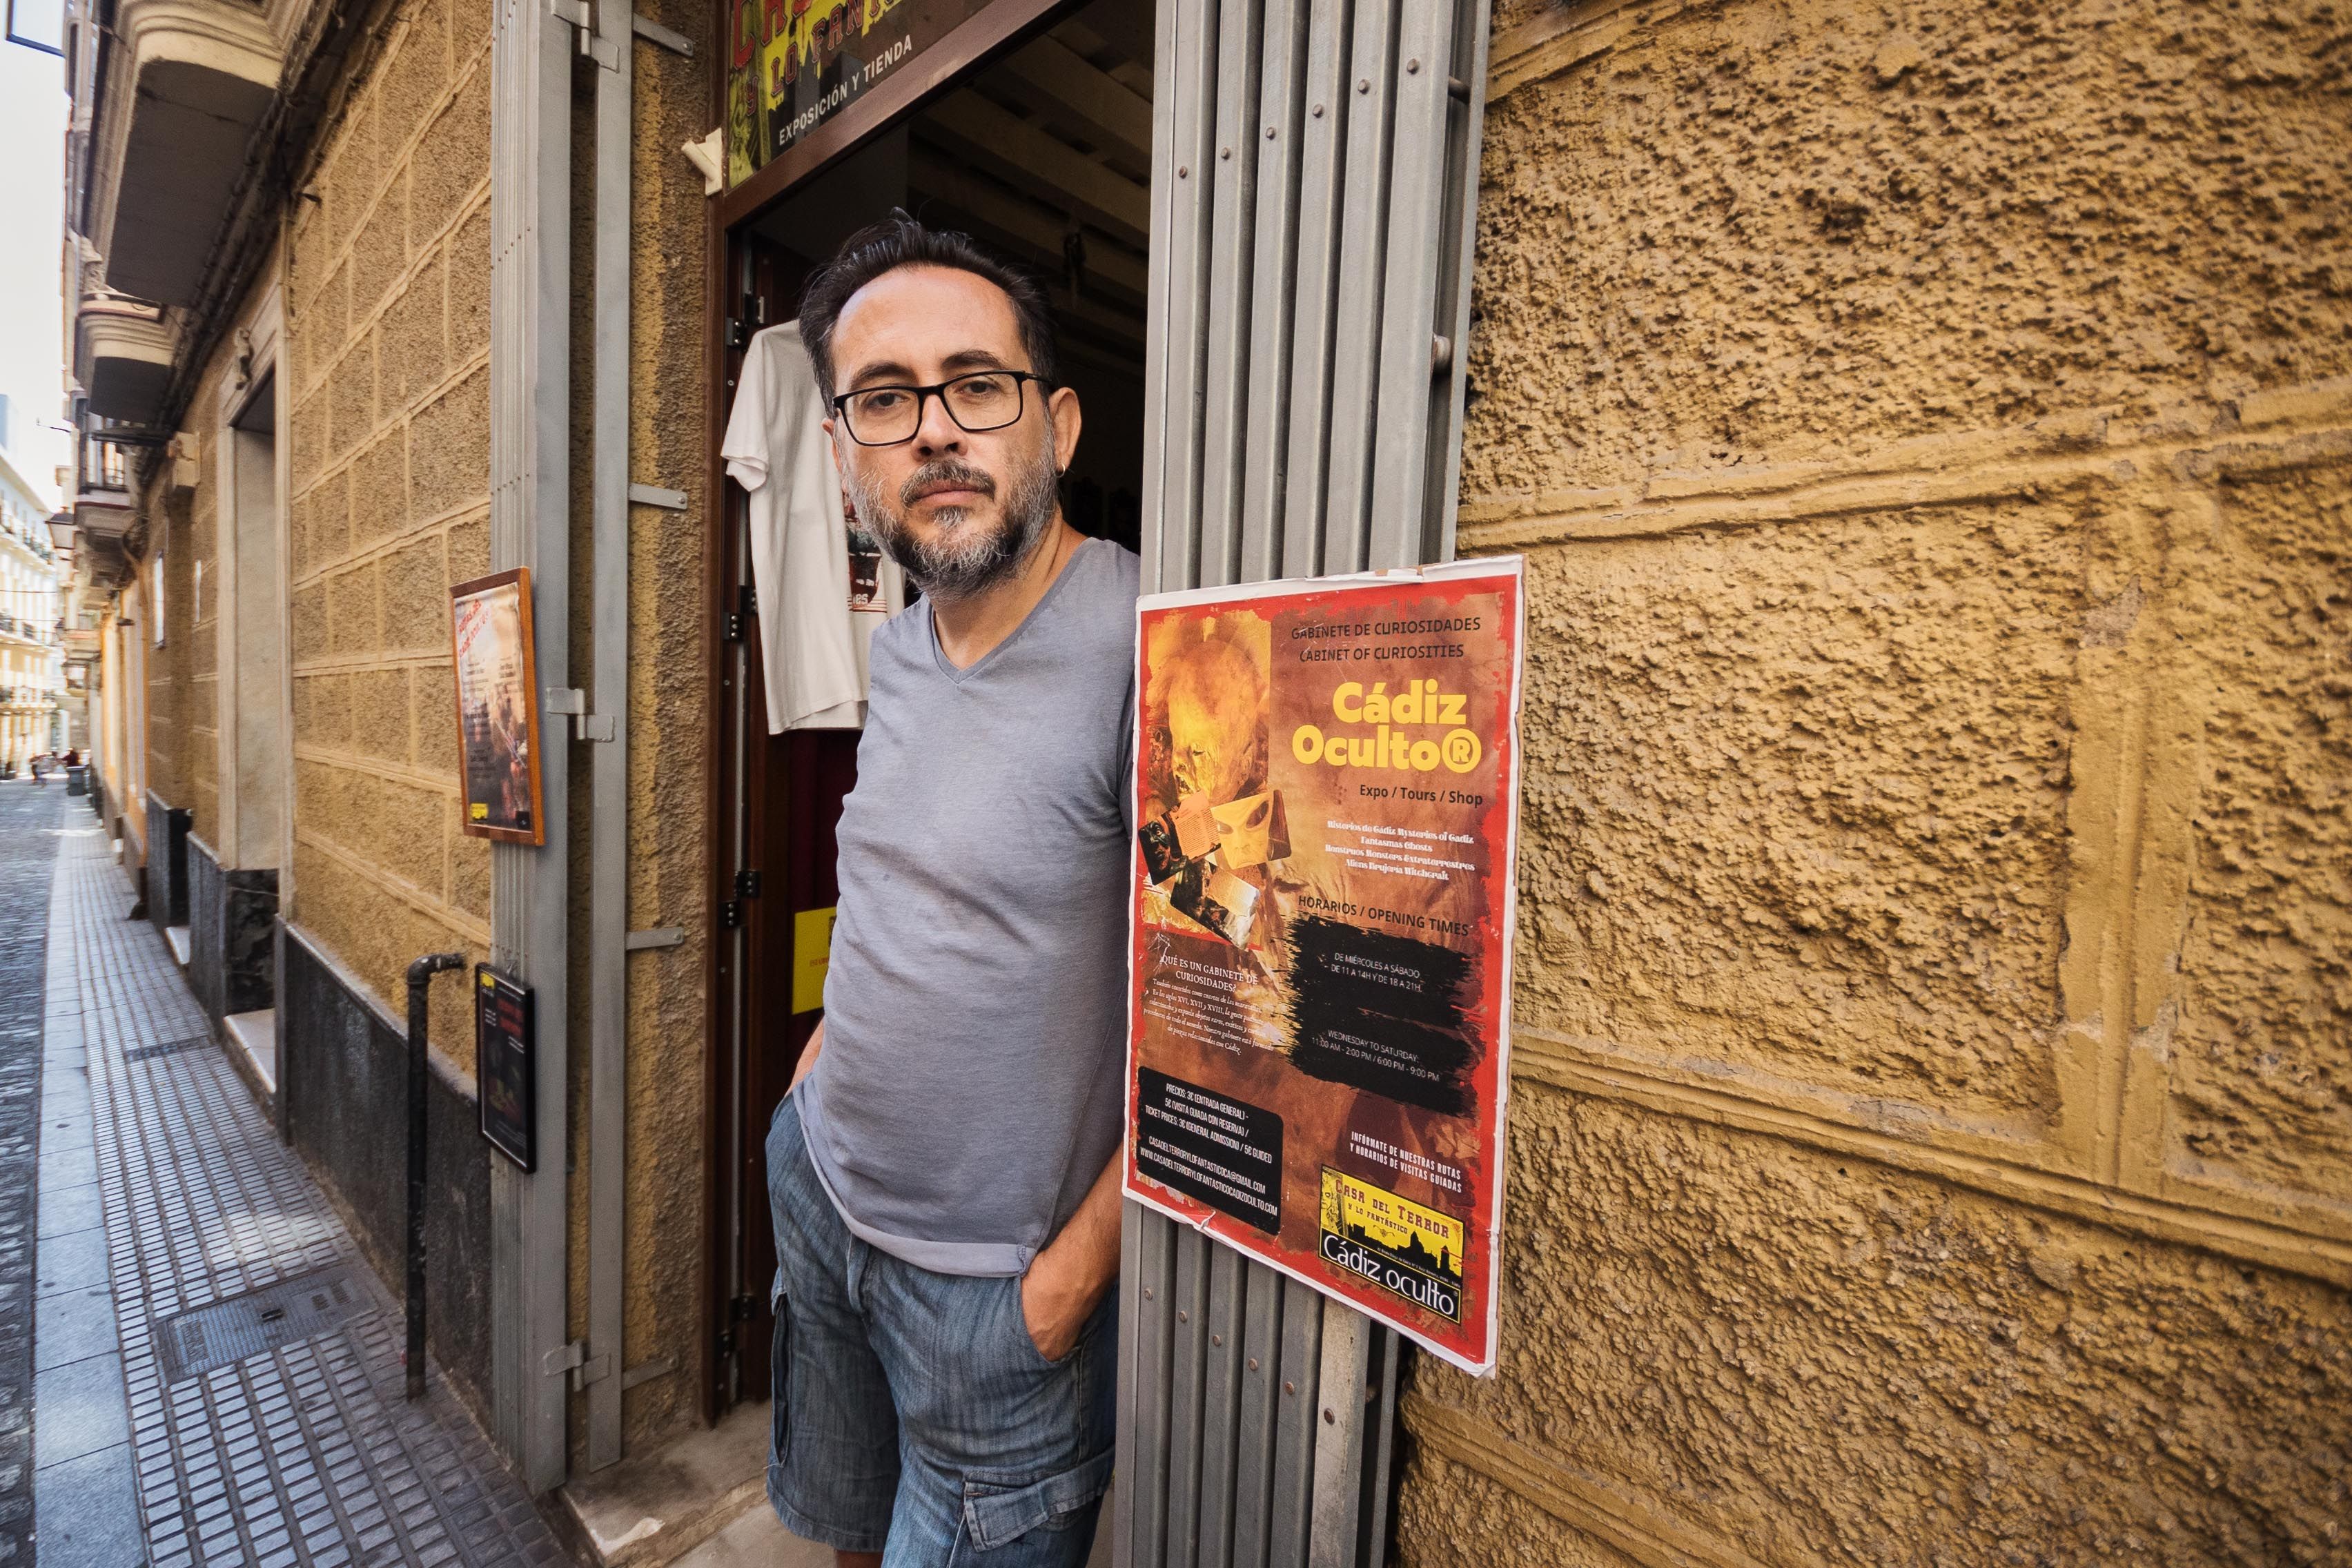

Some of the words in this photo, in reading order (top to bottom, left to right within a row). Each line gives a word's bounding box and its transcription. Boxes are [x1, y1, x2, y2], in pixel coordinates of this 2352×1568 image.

[770, 43, 798, 97] LO
[779, 81, 847, 146] EXPOSICIÓN
[852, 72, 860, 91] Y
[863, 35, 912, 83] TIENDA
[1291, 625, 1350, 640] GABINETE
[1354, 623, 1371, 636] DE
[1374, 617, 1481, 635] CURIOSIDADES
[1300, 649, 1350, 663] CABINET
[1353, 648, 1370, 660] OF
[1374, 644, 1464, 660] CURIOSITIES
[1333, 678, 1467, 725] Cádiz
[1360, 784, 1389, 800] Expo
[1391, 787, 1397, 798] /
[1400, 787, 1437, 802] Tours
[1440, 790, 1445, 801] /
[1448, 791, 1483, 808] Shop
[1360, 836, 1403, 849] Fantasmas
[1404, 841, 1433, 852] Ghosts
[1297, 895, 1357, 916] HORARIOS
[1360, 906, 1365, 917] /
[1368, 908, 1425, 929] OPENING
[1429, 918, 1469, 937] TIMES
[1179, 959, 1188, 968] ES
[1190, 961, 1202, 972] UN
[1203, 965, 1244, 982] GABINETE
[1246, 975, 1259, 985] DE
[1331, 963, 1340, 973] DE
[1342, 966, 1349, 975] 11
[1358, 970, 1371, 980] 14H
[1372, 972, 1378, 981] Y
[1378, 974, 1388, 984] DE
[1389, 977, 1398, 986] 18
[1334, 952, 1344, 961] DE
[1344, 954, 1383, 970] MIÉRCOLES
[1384, 963, 1389, 972] A
[1391, 964, 1420, 979] SÁBADO
[1175, 970, 1236, 992] CURIOSIDADES?
[1177, 995, 1189, 1005] XVI,
[1190, 999, 1203, 1008] XVII
[1207, 1003, 1224, 1015] XVIII,
[1327, 1029, 1368, 1047] WEDNESDAY
[1370, 1041, 1380, 1051] TO
[1329, 1043, 1341, 1052] AM
[1346, 1046, 1360, 1058] 2:00
[1360, 1051, 1371, 1062] PM
[1377, 1056, 1393, 1068] 6:00
[1393, 1060, 1405, 1072] PM
[1410, 1066, 1426, 1079] 9:00
[1427, 1070, 1440, 1082] PM
[1166, 1082, 1186, 1098] PRECIOS:
[1189, 1108, 1208, 1121] GUIADA
[1208, 1115, 1219, 1126] CON
[1145, 1104, 1161, 1119] TICKET
[1161, 1110, 1179, 1126] PRICES:
[1253, 1150, 1273, 1164] GUIDED
[1349, 1142, 1354, 1152] Y
[1355, 1145, 1388, 1166] HORARIOS
[1389, 1157, 1398, 1170] DE
[1400, 1162, 1429, 1181] VISITAS
[1429, 1173, 1462, 1193] GUIADAS
[1351, 1130, 1388, 1153] INFÓRMATE
[1389, 1145, 1398, 1157] DE
[1400, 1148, 1435, 1171] NUESTRAS
[1437, 1162, 1462, 1181] RUTAS
[1355, 1206, 1364, 1215] LO
[1366, 1211, 1409, 1235] FANTÁSTICO
[1372, 1198, 1390, 1214] DEL
[1398, 1204, 1450, 1239] TERROR
[1324, 1235, 1381, 1282] Cádiz
[1386, 1269, 1455, 1315] oculto
